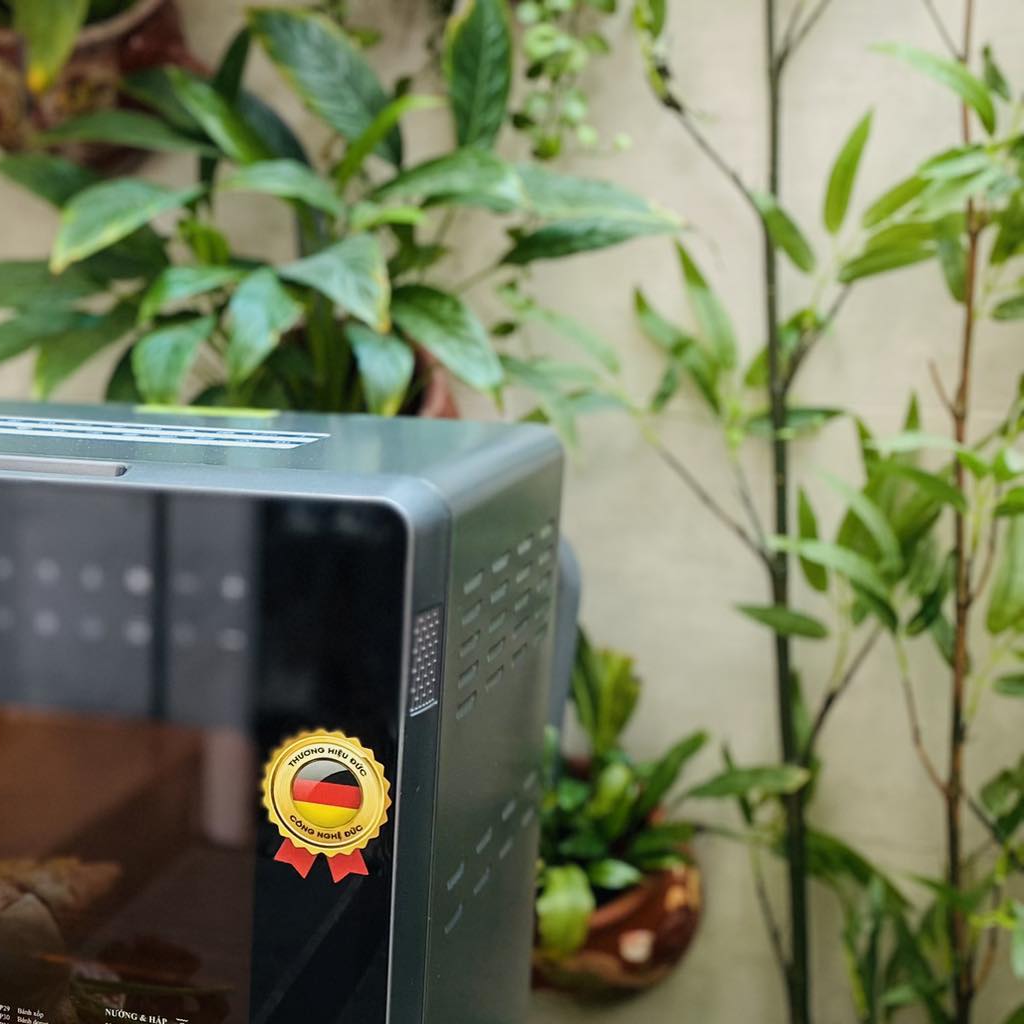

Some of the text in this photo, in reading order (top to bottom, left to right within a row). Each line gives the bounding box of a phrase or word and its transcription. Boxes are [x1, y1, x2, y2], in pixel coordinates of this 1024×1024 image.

[289, 815, 315, 835] CÔNG
[105, 1008, 137, 1020] NƯỚNG
[140, 1014, 147, 1022] &
